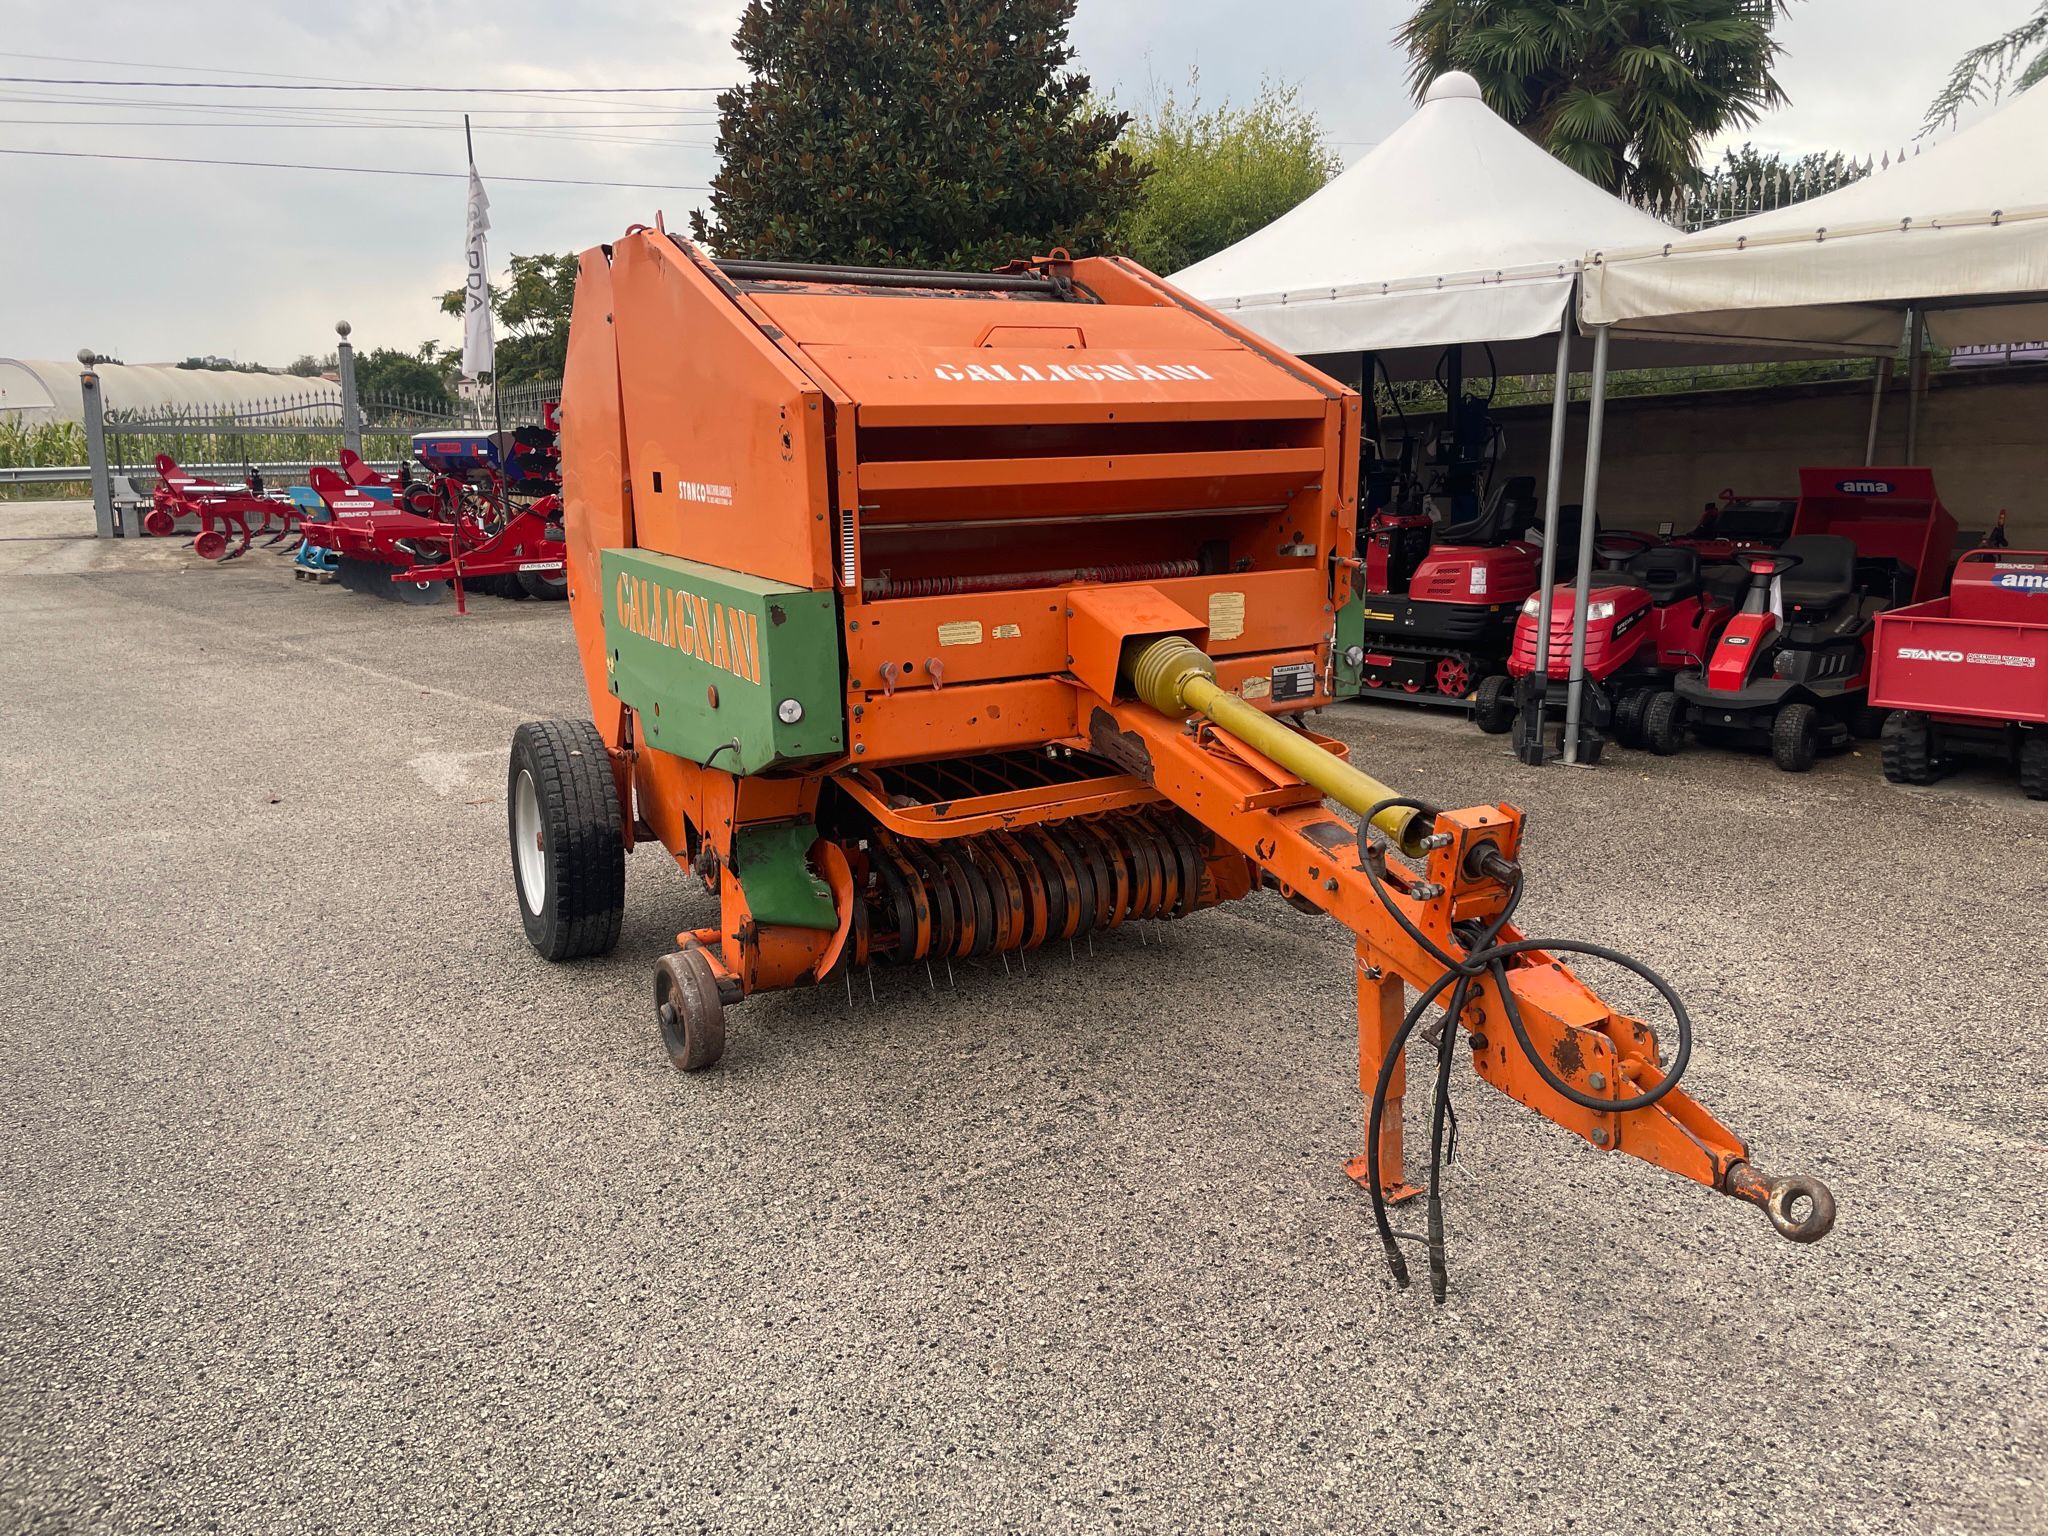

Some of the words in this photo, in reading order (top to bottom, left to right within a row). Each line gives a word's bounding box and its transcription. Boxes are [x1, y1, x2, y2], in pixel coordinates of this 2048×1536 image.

[934, 364, 1214, 381] GALLIGNANI
[679, 481, 706, 503] STANCO
[1843, 482, 1888, 493] ama
[616, 572, 761, 686] GALLIGNANI
[1897, 647, 1964, 662] STANCO
